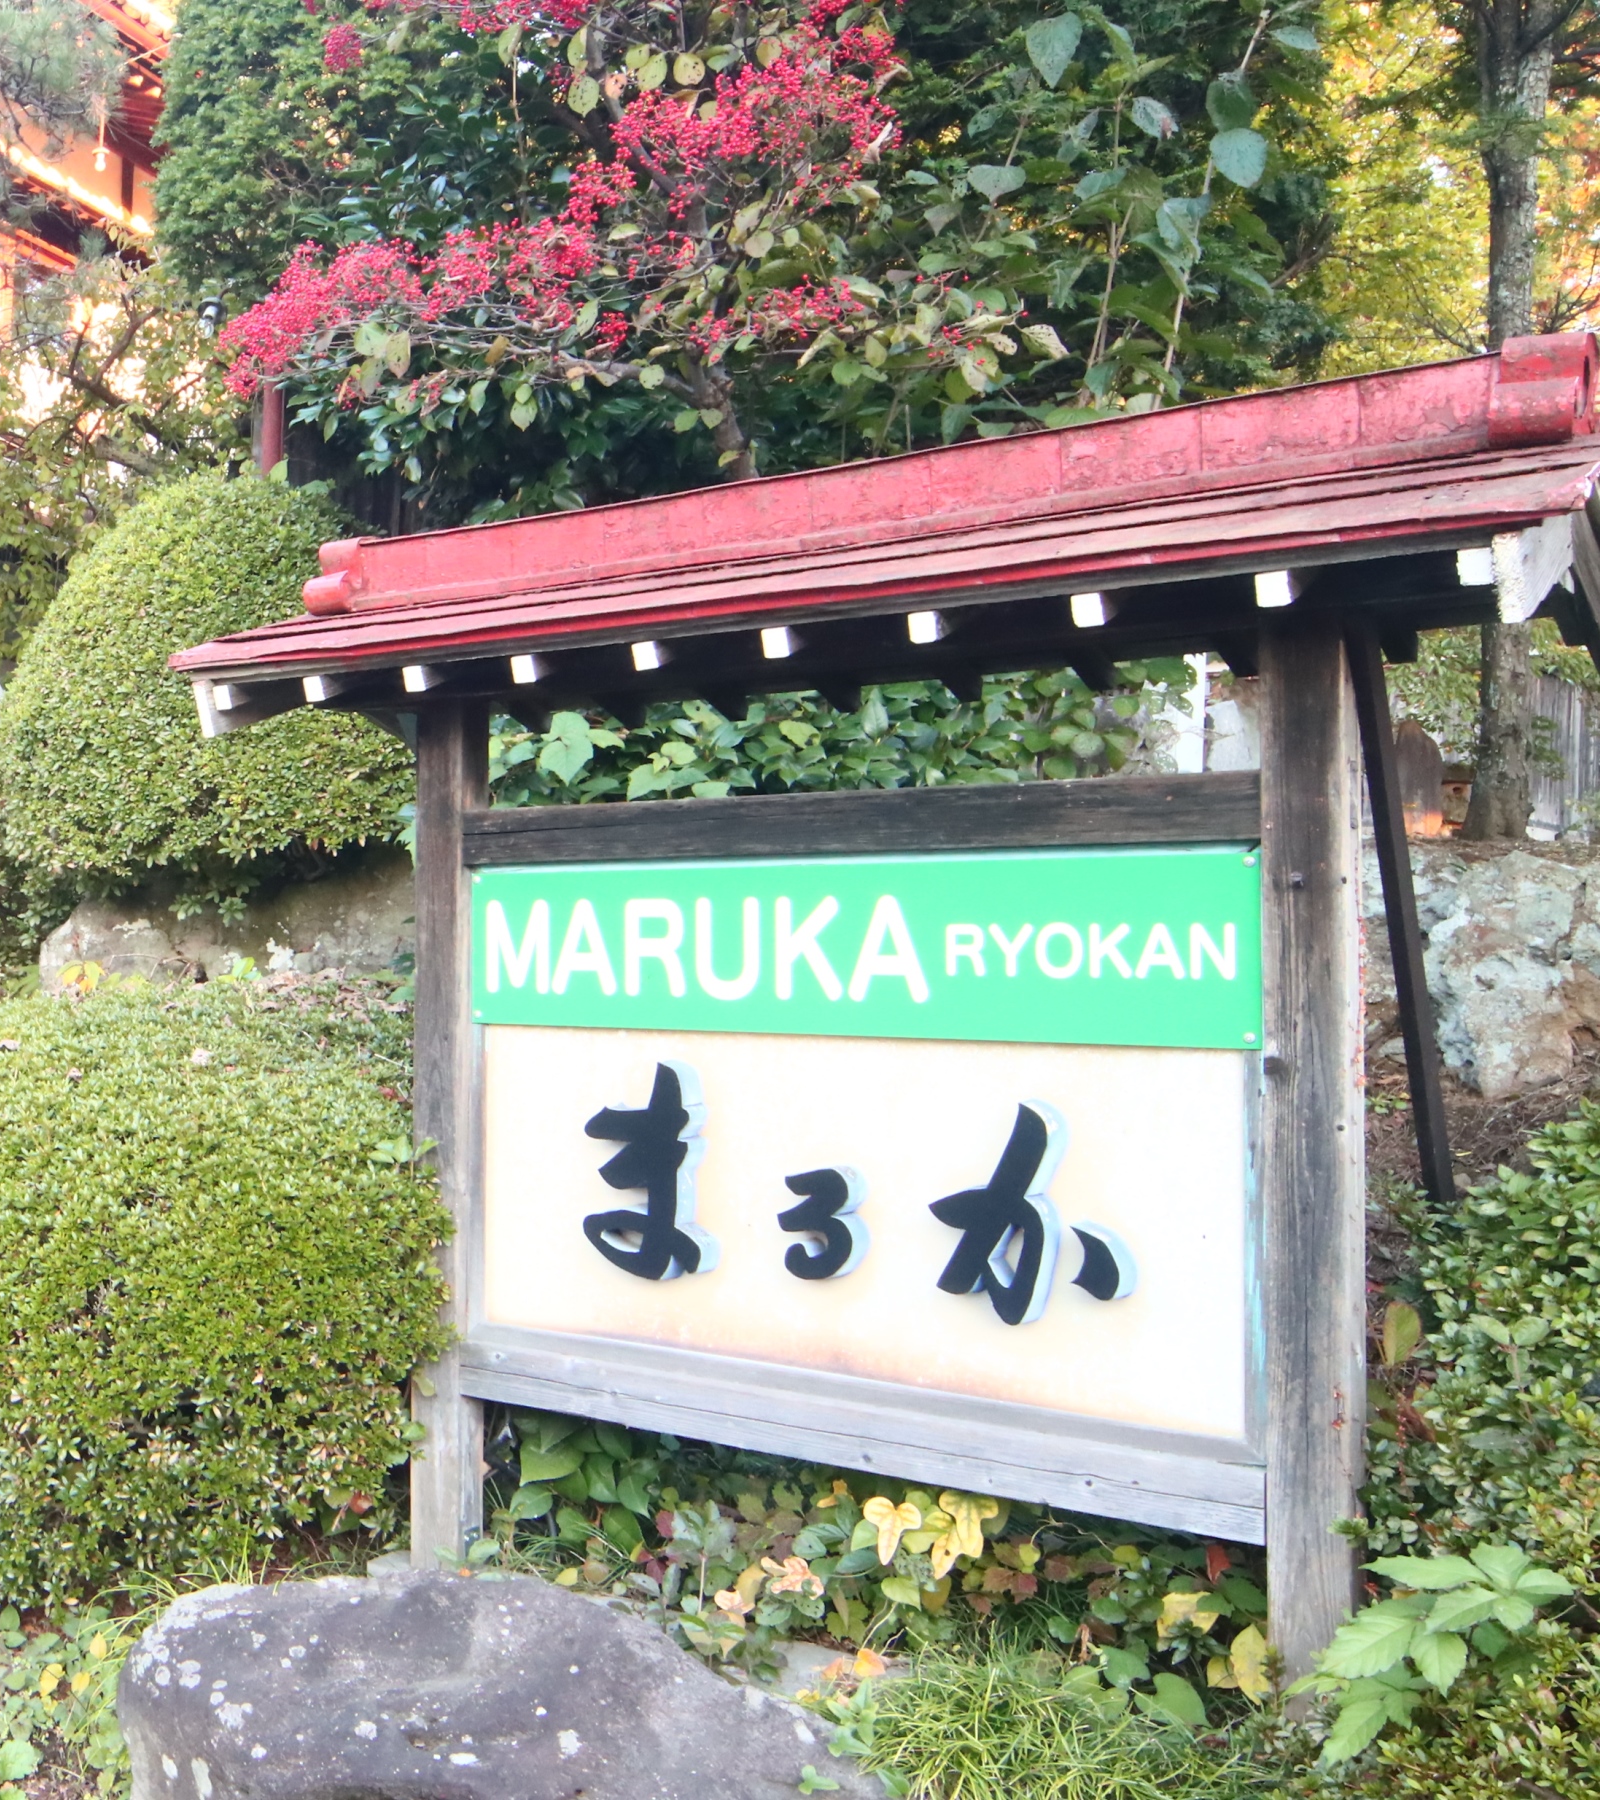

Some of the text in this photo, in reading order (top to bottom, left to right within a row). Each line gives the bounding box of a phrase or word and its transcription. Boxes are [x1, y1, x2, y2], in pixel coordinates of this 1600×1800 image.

[484, 893, 1238, 1004] MARUKA RYOKAN
[583, 1060, 1134, 1326] まるか
